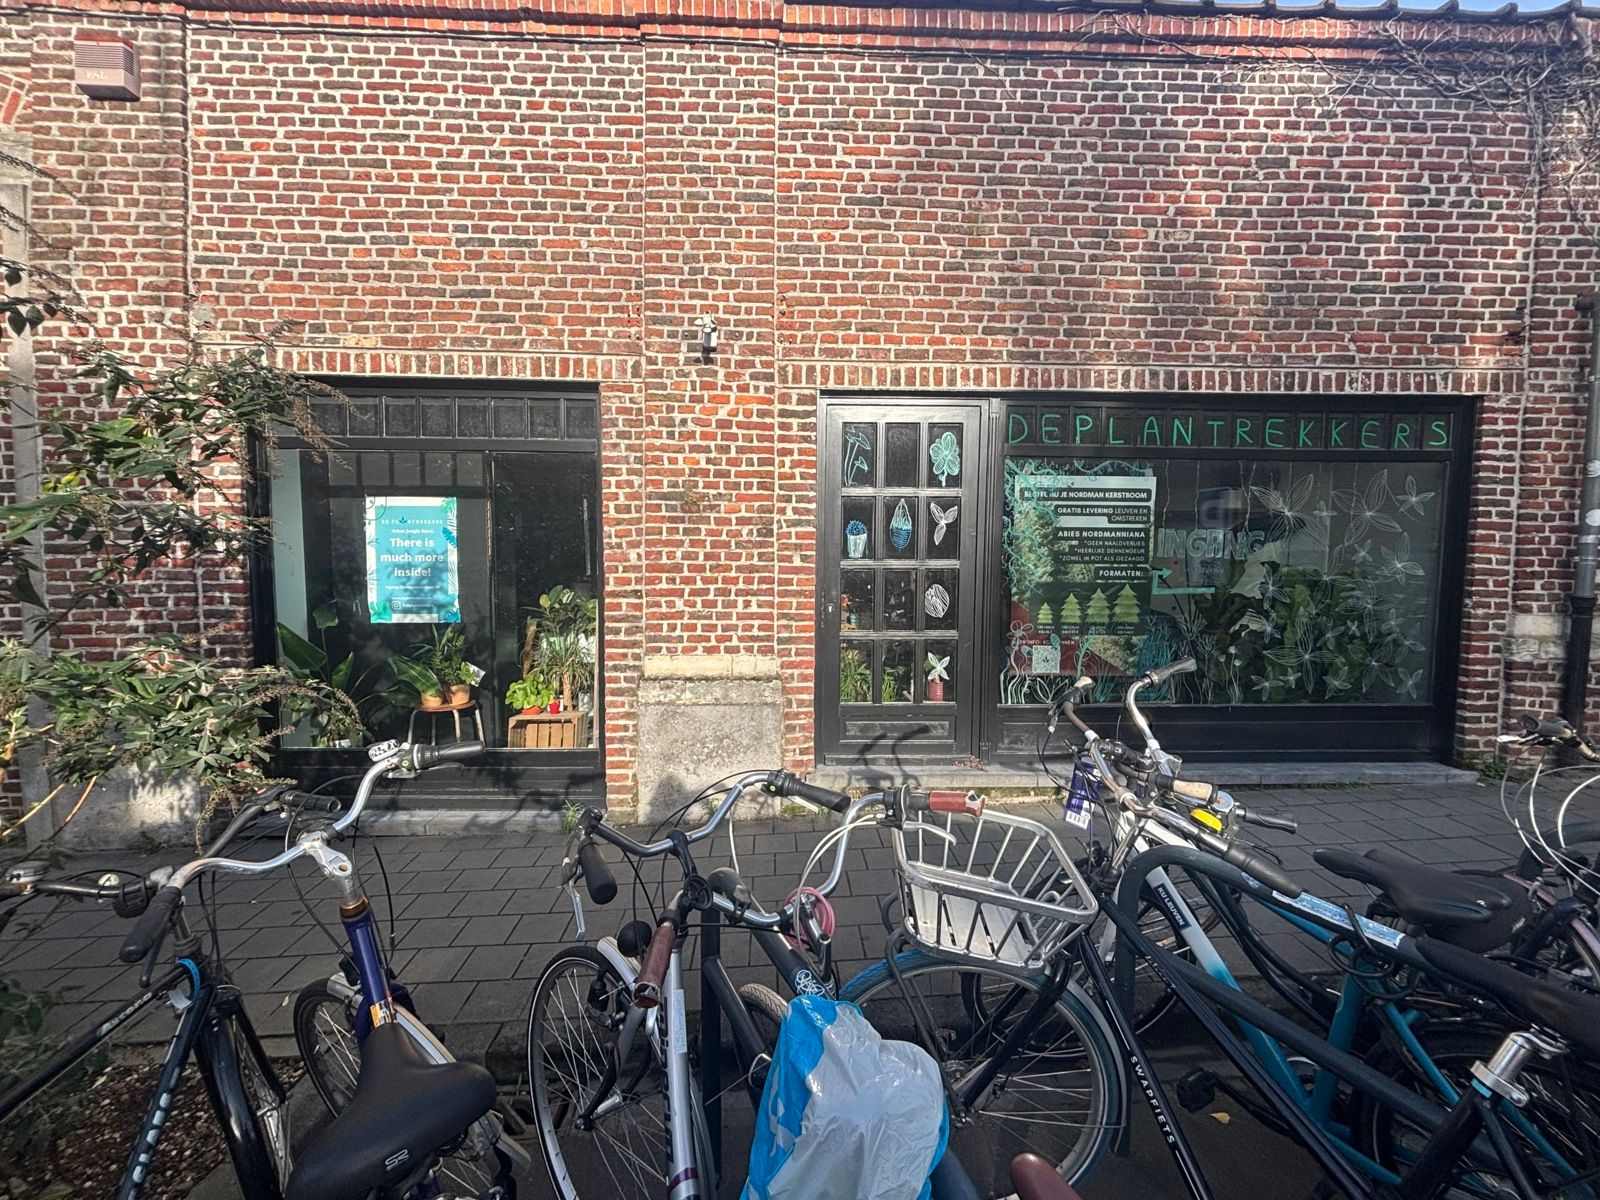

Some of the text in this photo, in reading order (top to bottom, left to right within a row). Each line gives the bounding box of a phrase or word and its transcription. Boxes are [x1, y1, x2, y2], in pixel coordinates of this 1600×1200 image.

[1069, 491, 1104, 499] NORDMAN
[1057, 530, 1146, 538] ABIES NORDMANNIANA
[390, 537, 435, 547] There is
[380, 552, 445, 562] much more
[394, 567, 432, 577] inside!
[1157, 886, 1185, 926] KU LEUVEN
[1130, 1055, 1175, 1144] SWAPFIETS
